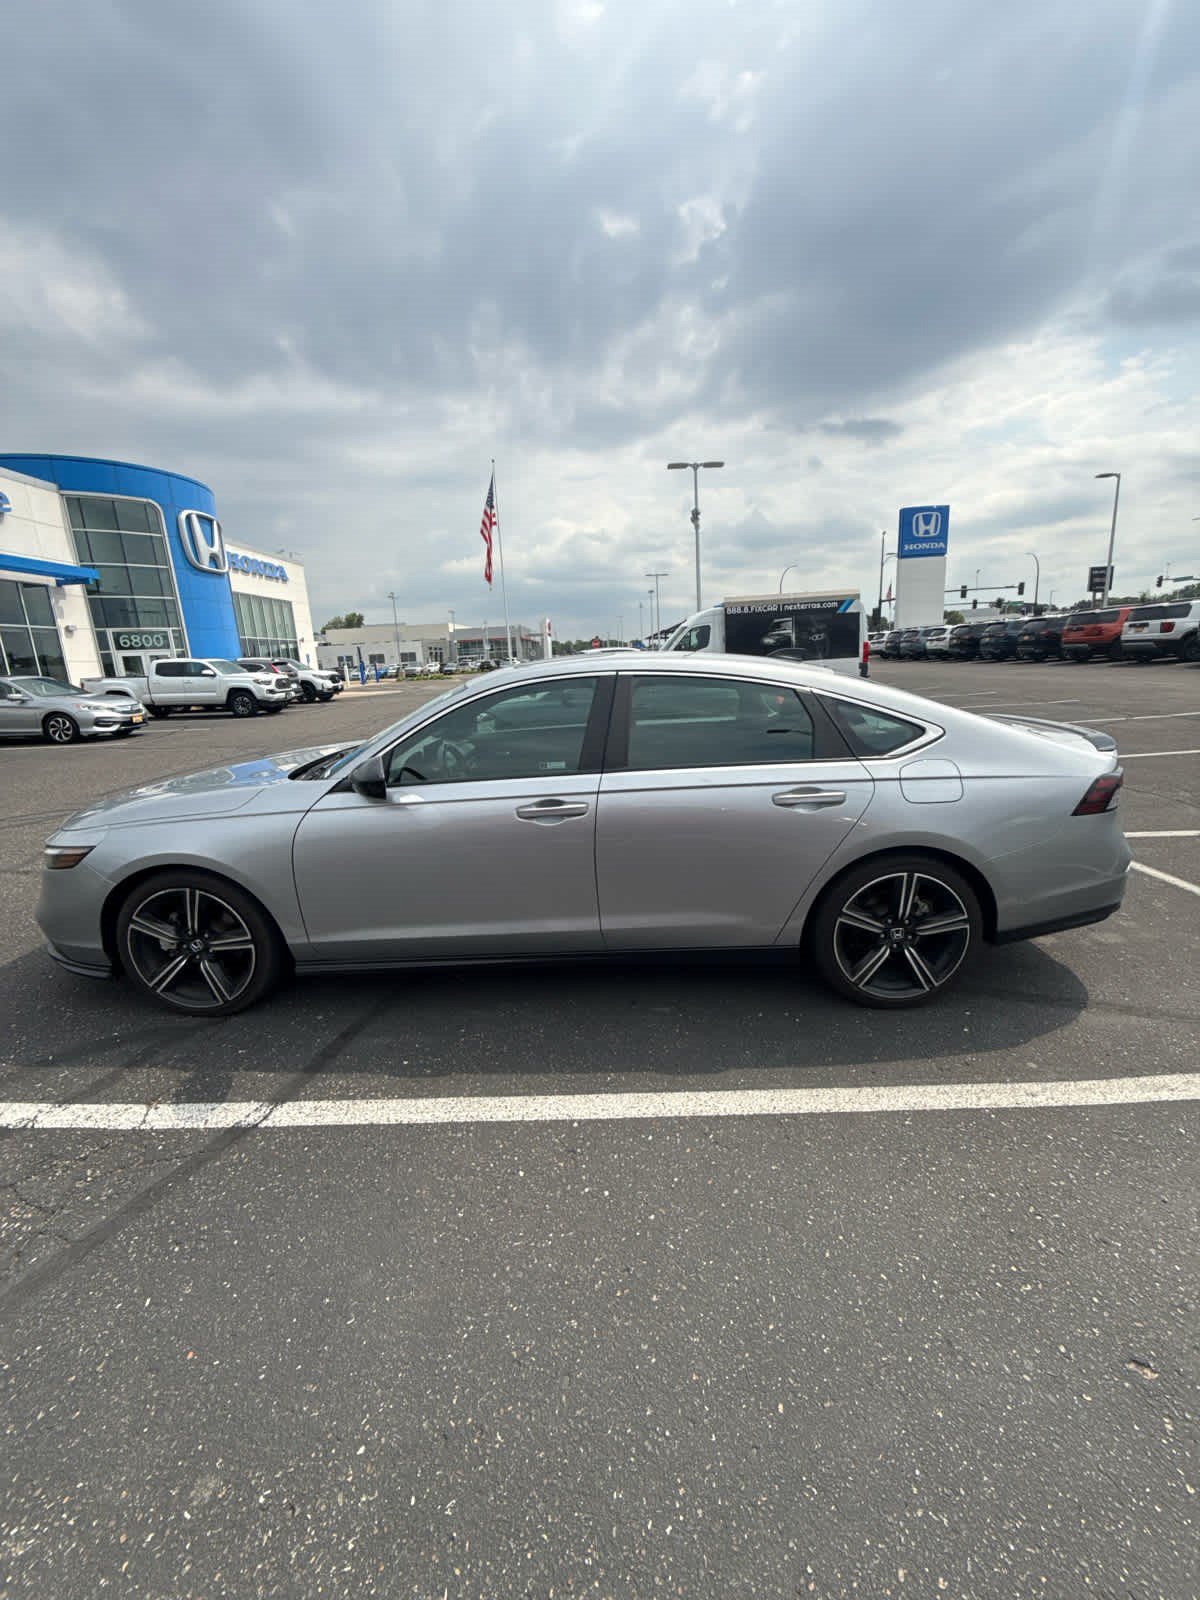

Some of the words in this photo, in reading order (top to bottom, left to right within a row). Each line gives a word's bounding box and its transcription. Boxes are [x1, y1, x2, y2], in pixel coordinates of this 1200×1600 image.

[903, 542, 945, 551] HONDA
[226, 551, 289, 583] HONDA
[119, 634, 164, 648] 6800
